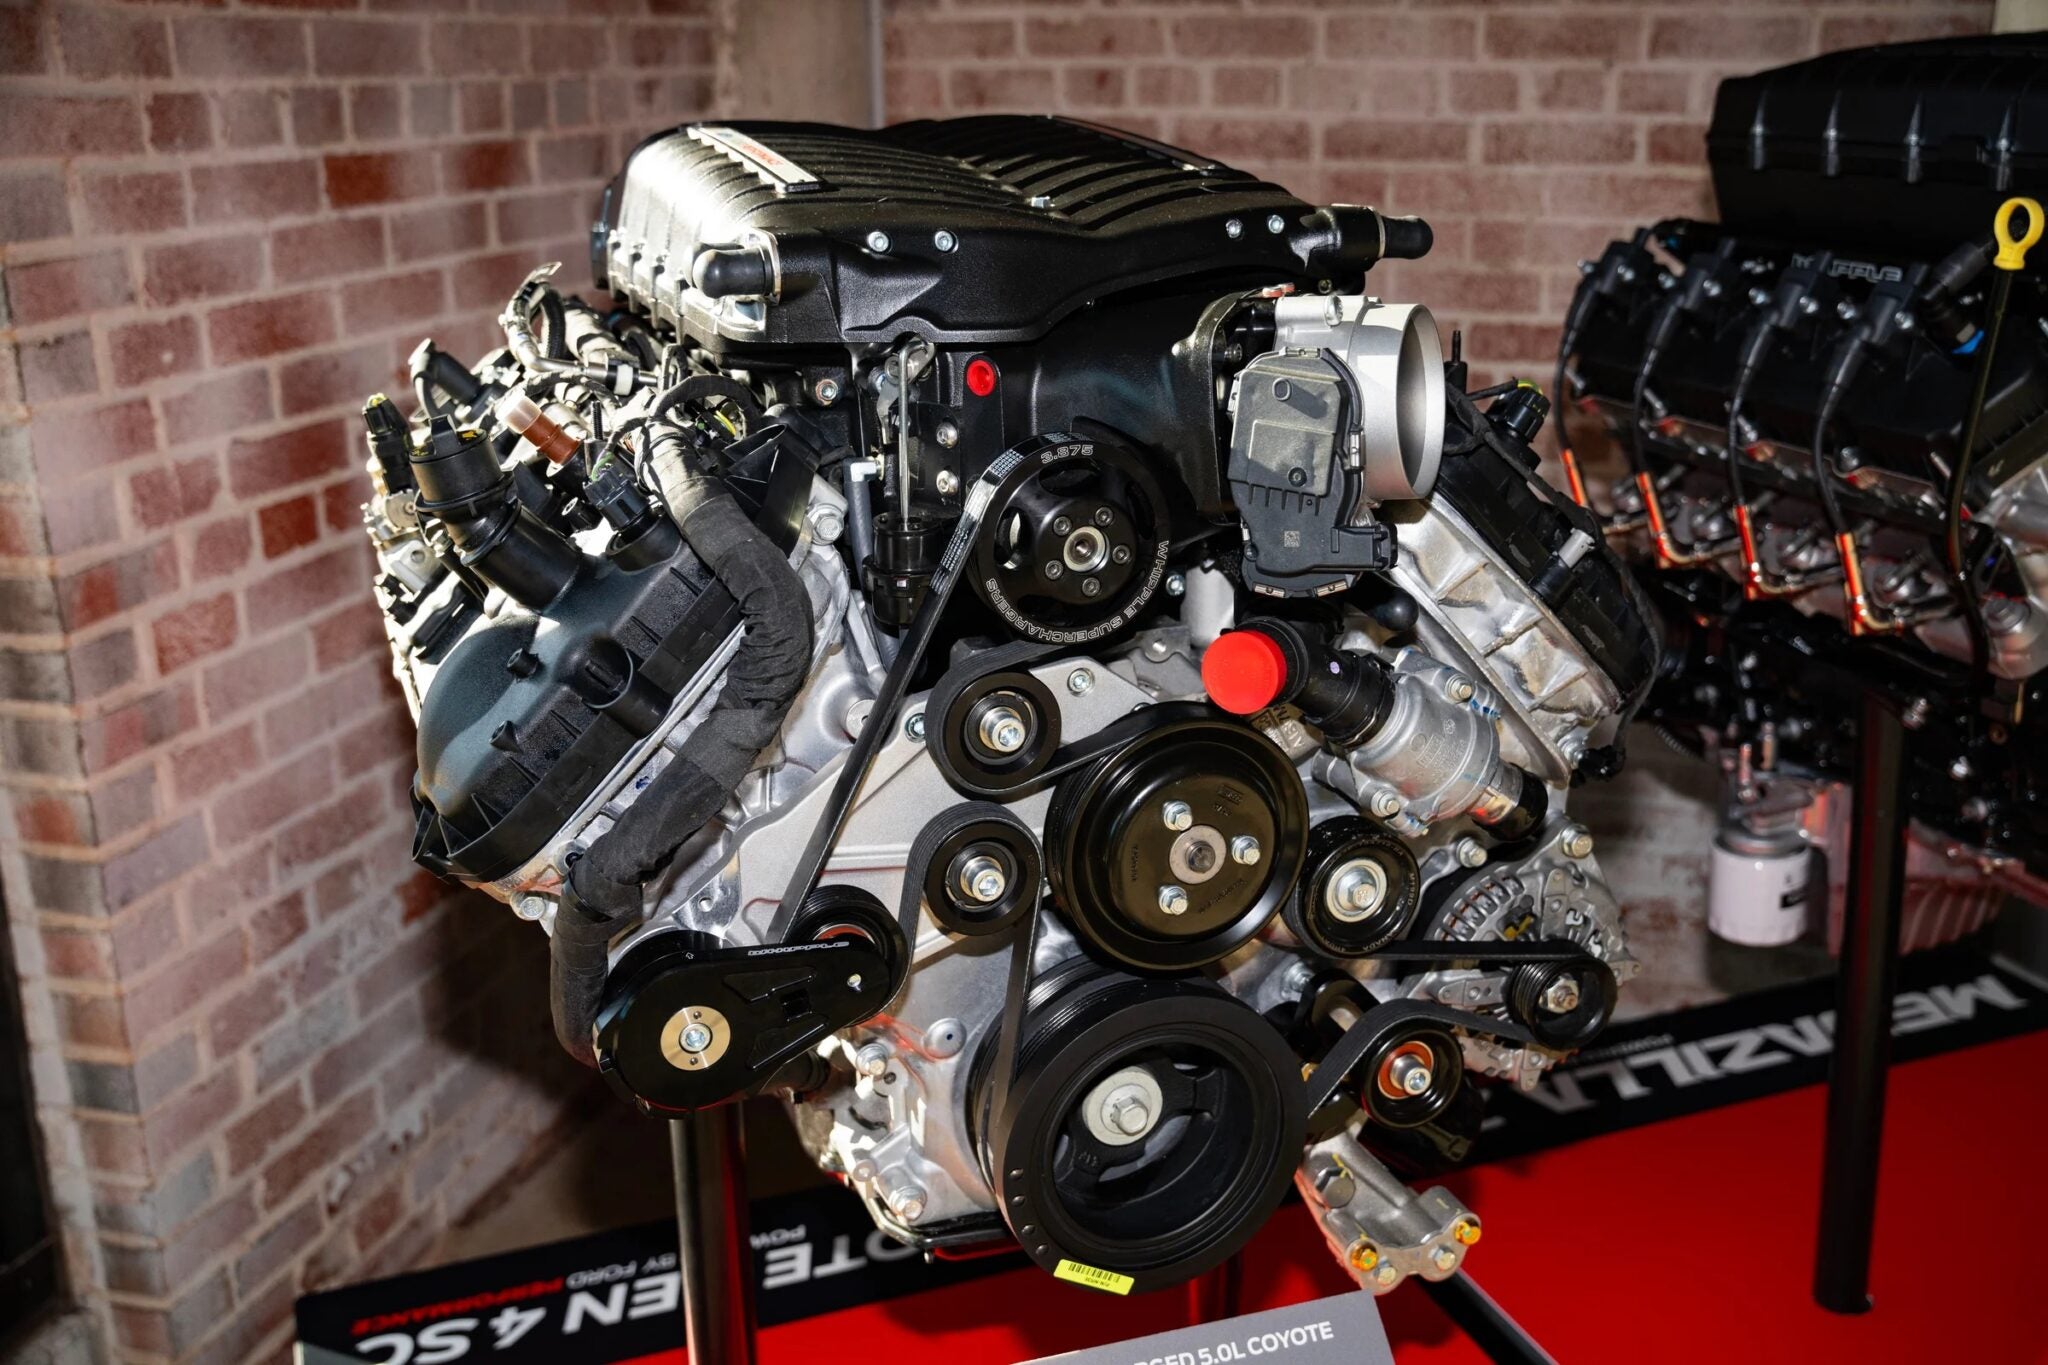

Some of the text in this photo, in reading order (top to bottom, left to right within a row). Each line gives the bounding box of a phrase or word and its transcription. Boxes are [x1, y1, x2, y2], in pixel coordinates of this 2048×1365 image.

[1040, 444, 1093, 463] 3.875
[985, 540, 1169, 643] WHIPPLE SUPERCHARGERS
[1519, 975, 2027, 1113] MEAZILLA
[566, 1260, 637, 1289] FORD
[642, 1252, 676, 1272] BY
[352, 1276, 564, 1336] PERFORMANCE
[489, 1306, 546, 1349] 4
[355, 1318, 479, 1365] SC
[1197, 1341, 1246, 1365] 5.0L
[1247, 1321, 1334, 1356] COYOTE
